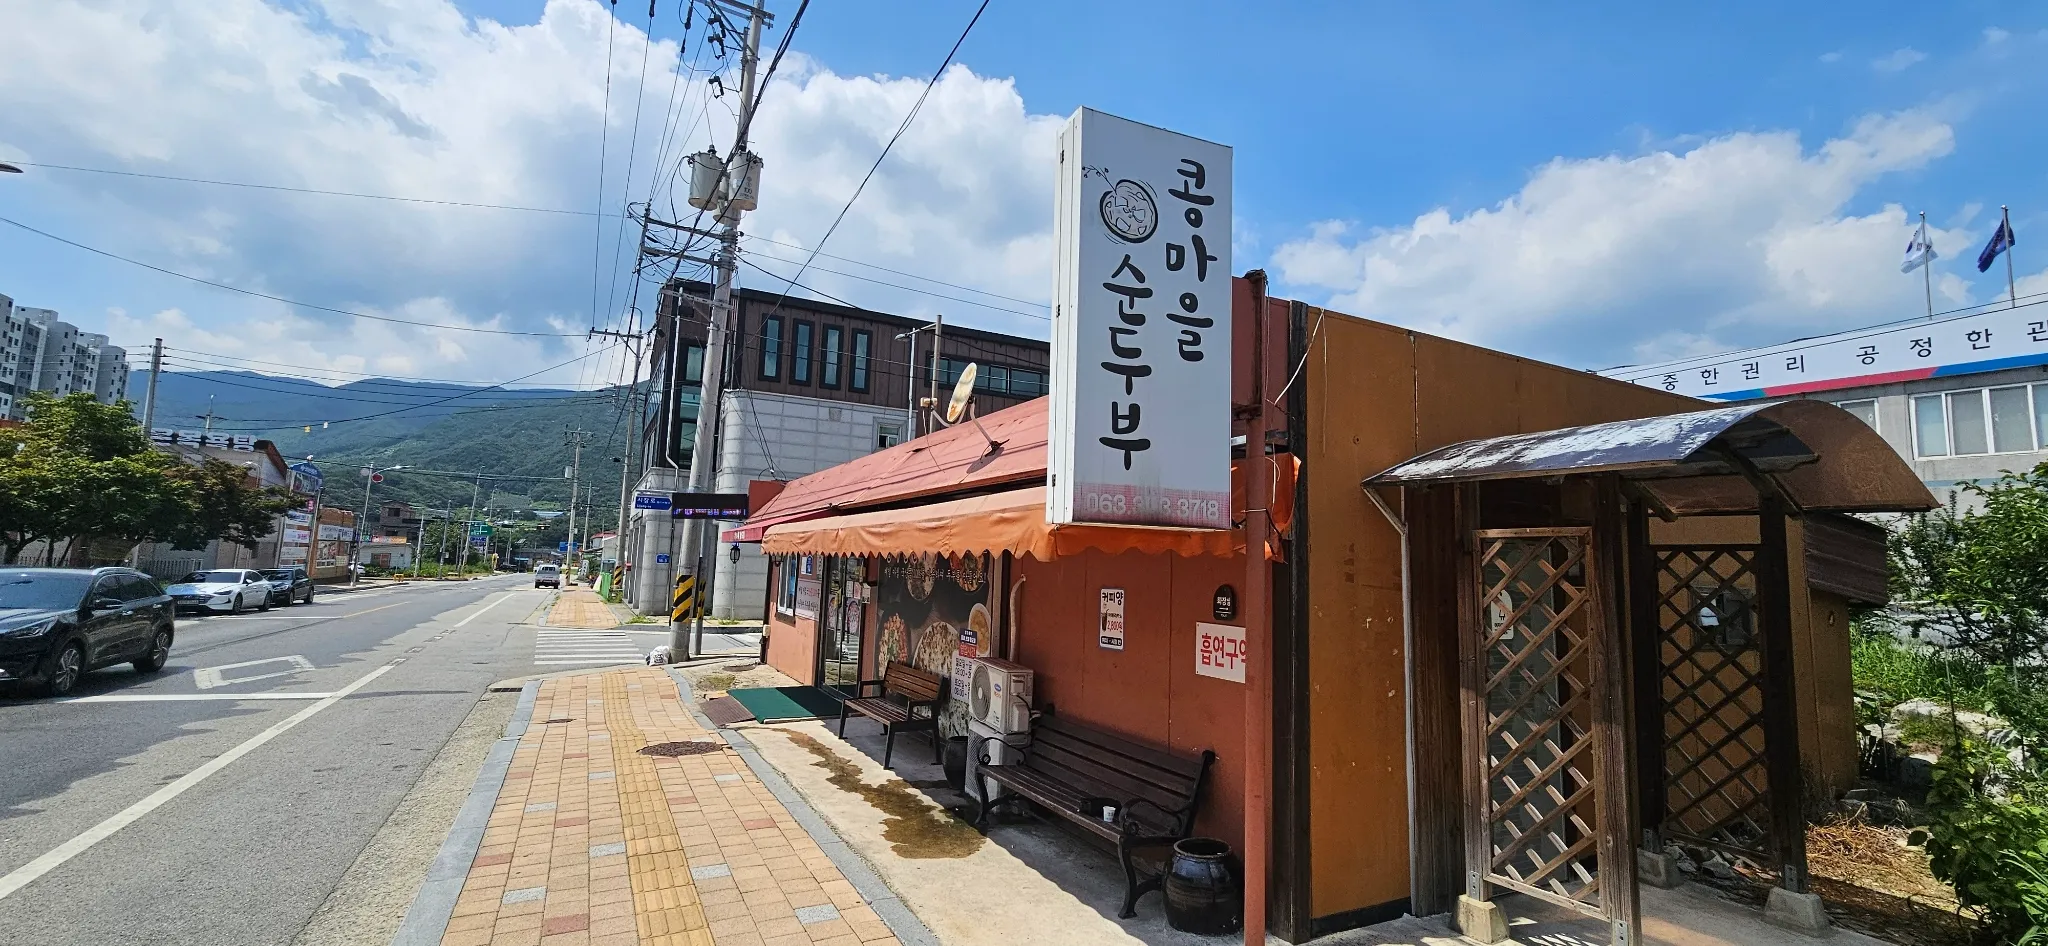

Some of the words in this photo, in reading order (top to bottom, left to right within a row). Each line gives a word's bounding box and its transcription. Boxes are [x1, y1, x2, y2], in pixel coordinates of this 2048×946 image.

[1165, 158, 1218, 362] 콩마을
[1099, 254, 1154, 471] 순두부
[1086, 492, 1219, 521] 063.33.3718
